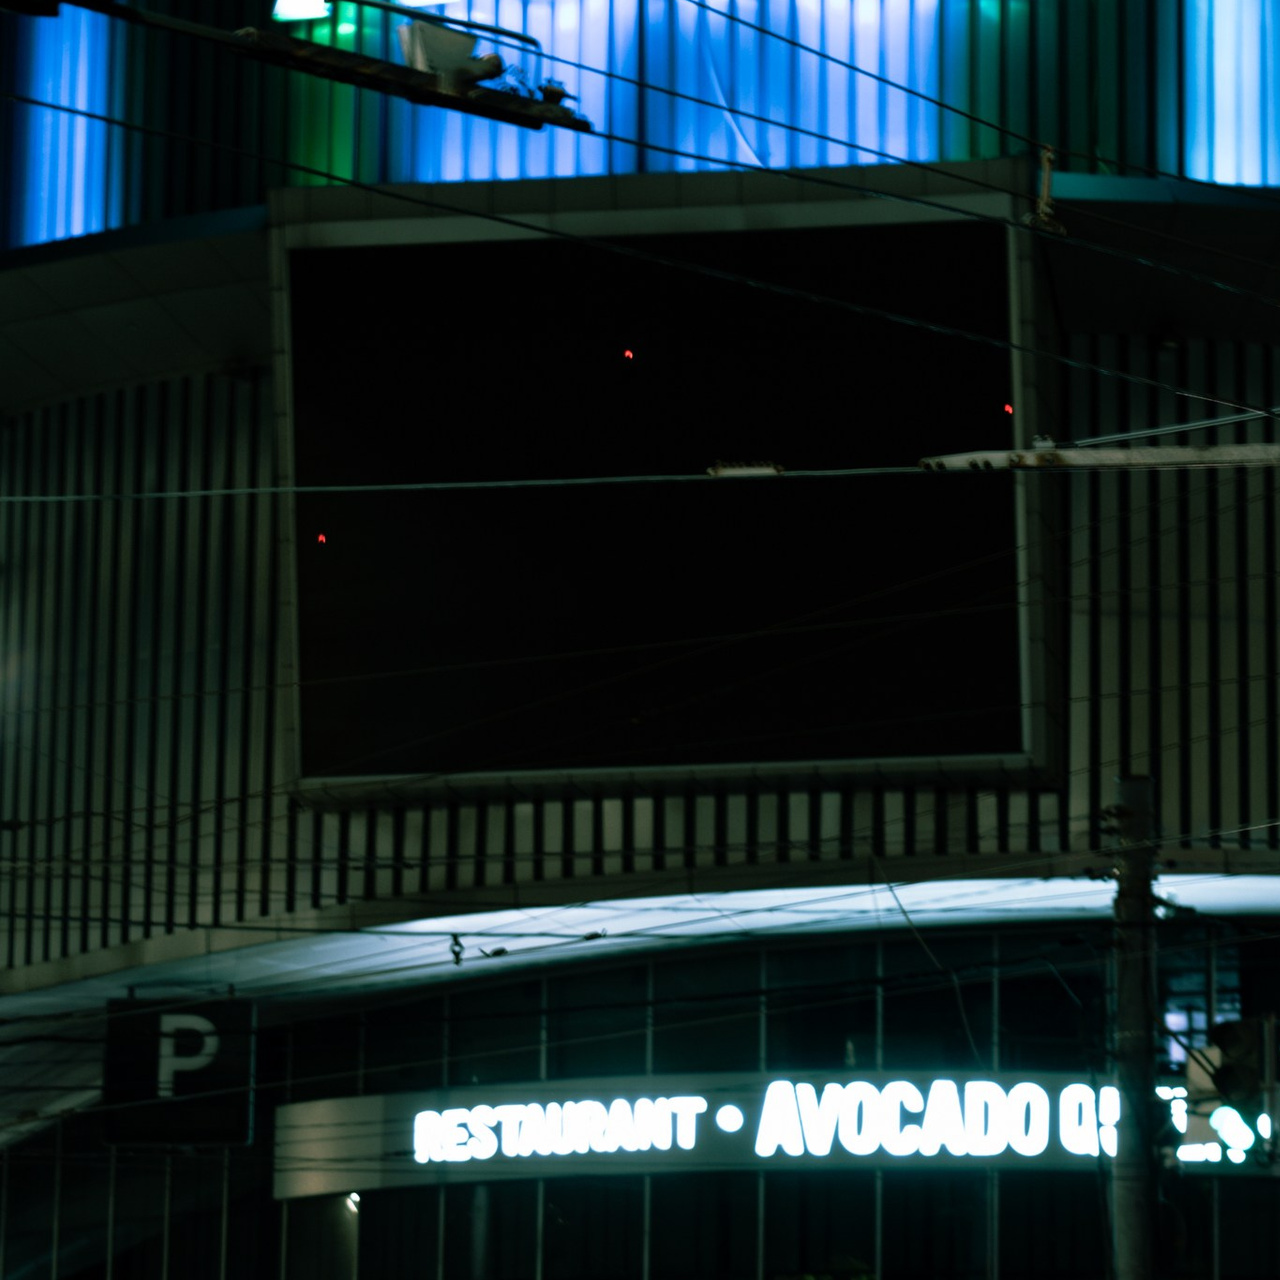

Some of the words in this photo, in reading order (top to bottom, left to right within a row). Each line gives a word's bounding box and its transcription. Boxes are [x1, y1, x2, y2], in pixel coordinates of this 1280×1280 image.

[157, 1014, 220, 1098] P
[413, 1095, 708, 1164] RESTAURANT
[754, 1078, 1050, 1157] AVOCADO
